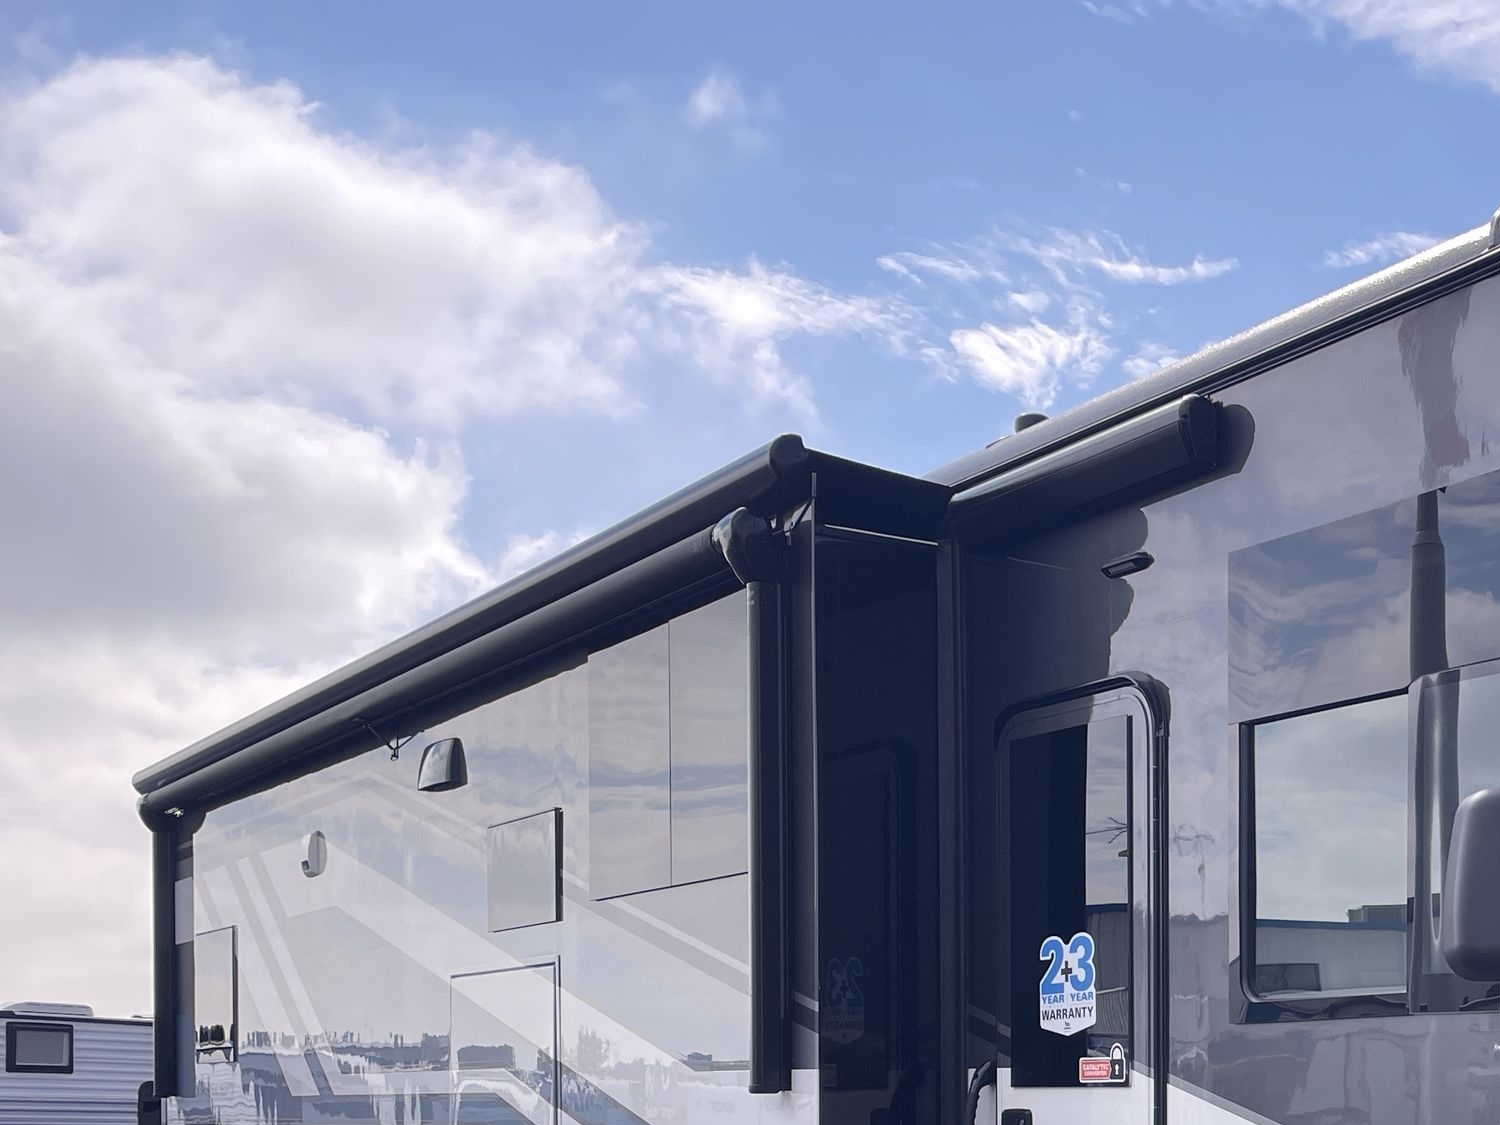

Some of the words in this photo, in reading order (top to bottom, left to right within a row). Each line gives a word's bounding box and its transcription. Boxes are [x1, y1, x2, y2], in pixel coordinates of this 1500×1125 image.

[1041, 994, 1065, 1005] YEAR
[1070, 991, 1094, 1002] YEAR
[1041, 1006, 1094, 1021] WARRANTY
